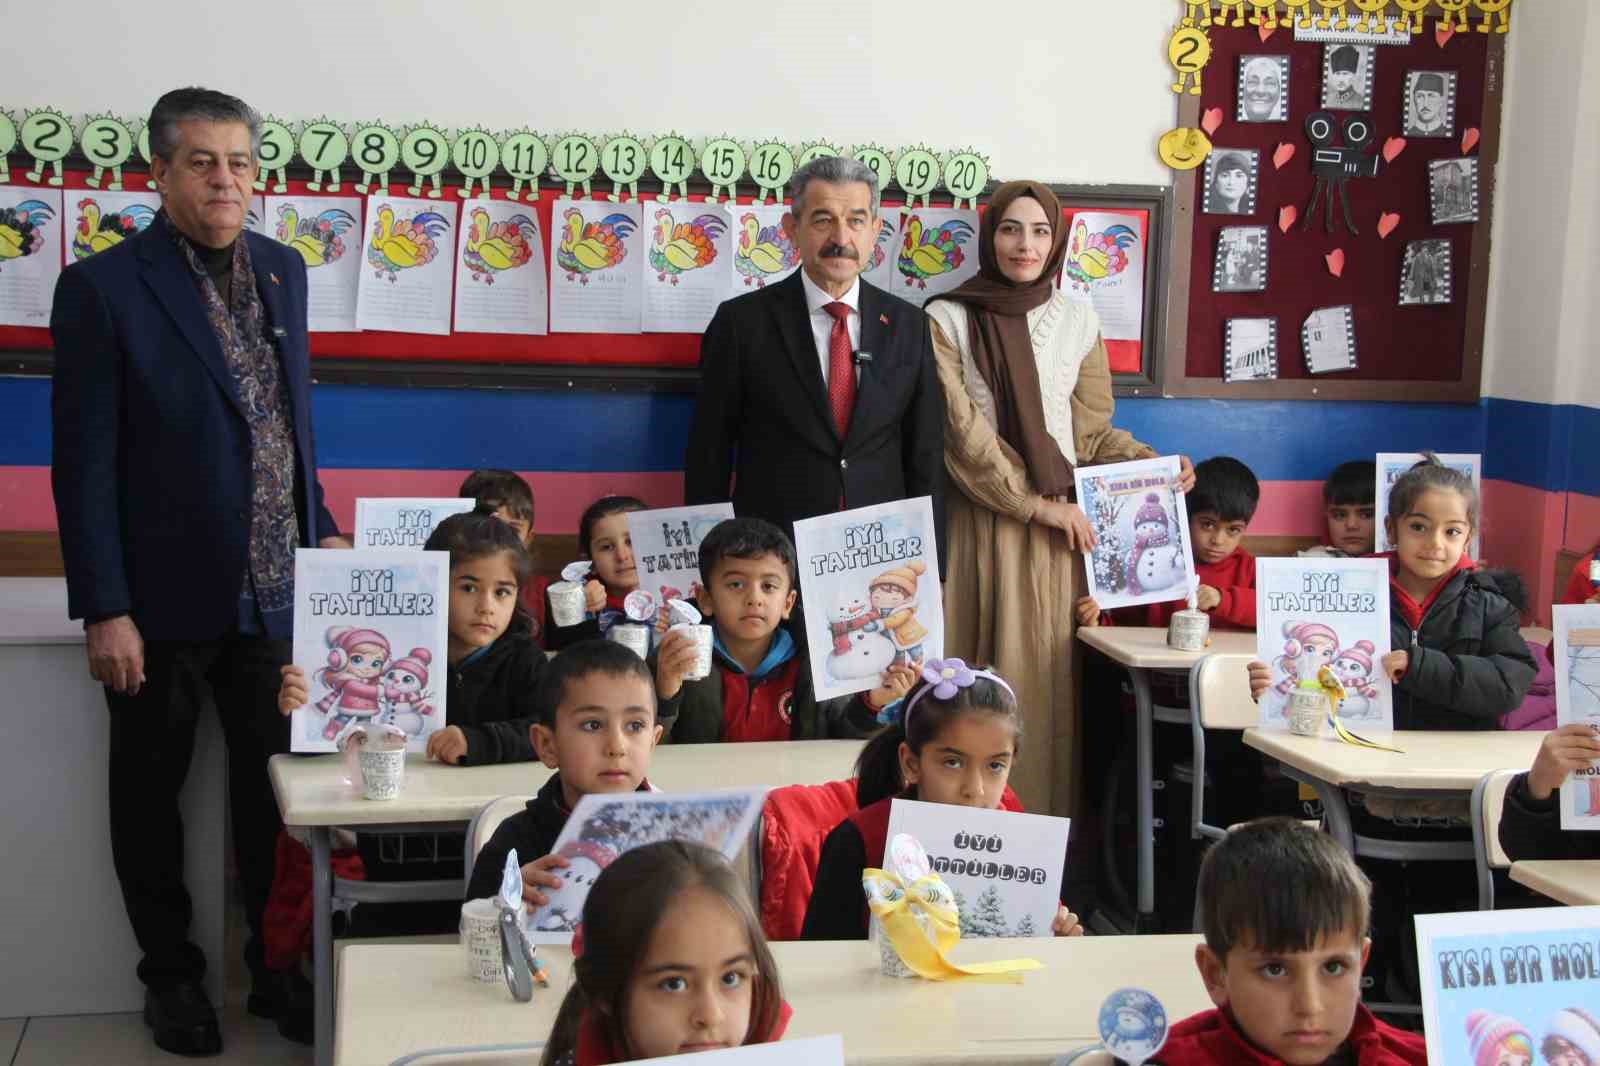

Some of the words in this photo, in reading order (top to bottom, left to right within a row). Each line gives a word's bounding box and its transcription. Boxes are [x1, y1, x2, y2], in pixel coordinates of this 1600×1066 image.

[1176, 36, 1200, 68] 2
[33, 118, 61, 153] 2
[92, 126, 120, 159] 3
[258, 129, 281, 161] 6
[310, 129, 336, 162] 7
[360, 133, 386, 165] 8
[412, 137, 438, 169] 9
[461, 137, 488, 170] 10
[511, 142, 536, 175] 11
[563, 142, 588, 173] 12
[611, 144, 636, 176] 13
[661, 144, 686, 176] 14
[709, 148, 735, 179] 15
[756, 150, 782, 181] 16
[906, 159, 931, 189] 19
[951, 159, 977, 191] 20
[926, 854, 1047, 885] TTİLLER
[1438, 947, 1497, 989] KISA
[1548, 941, 1600, 981] MOL
